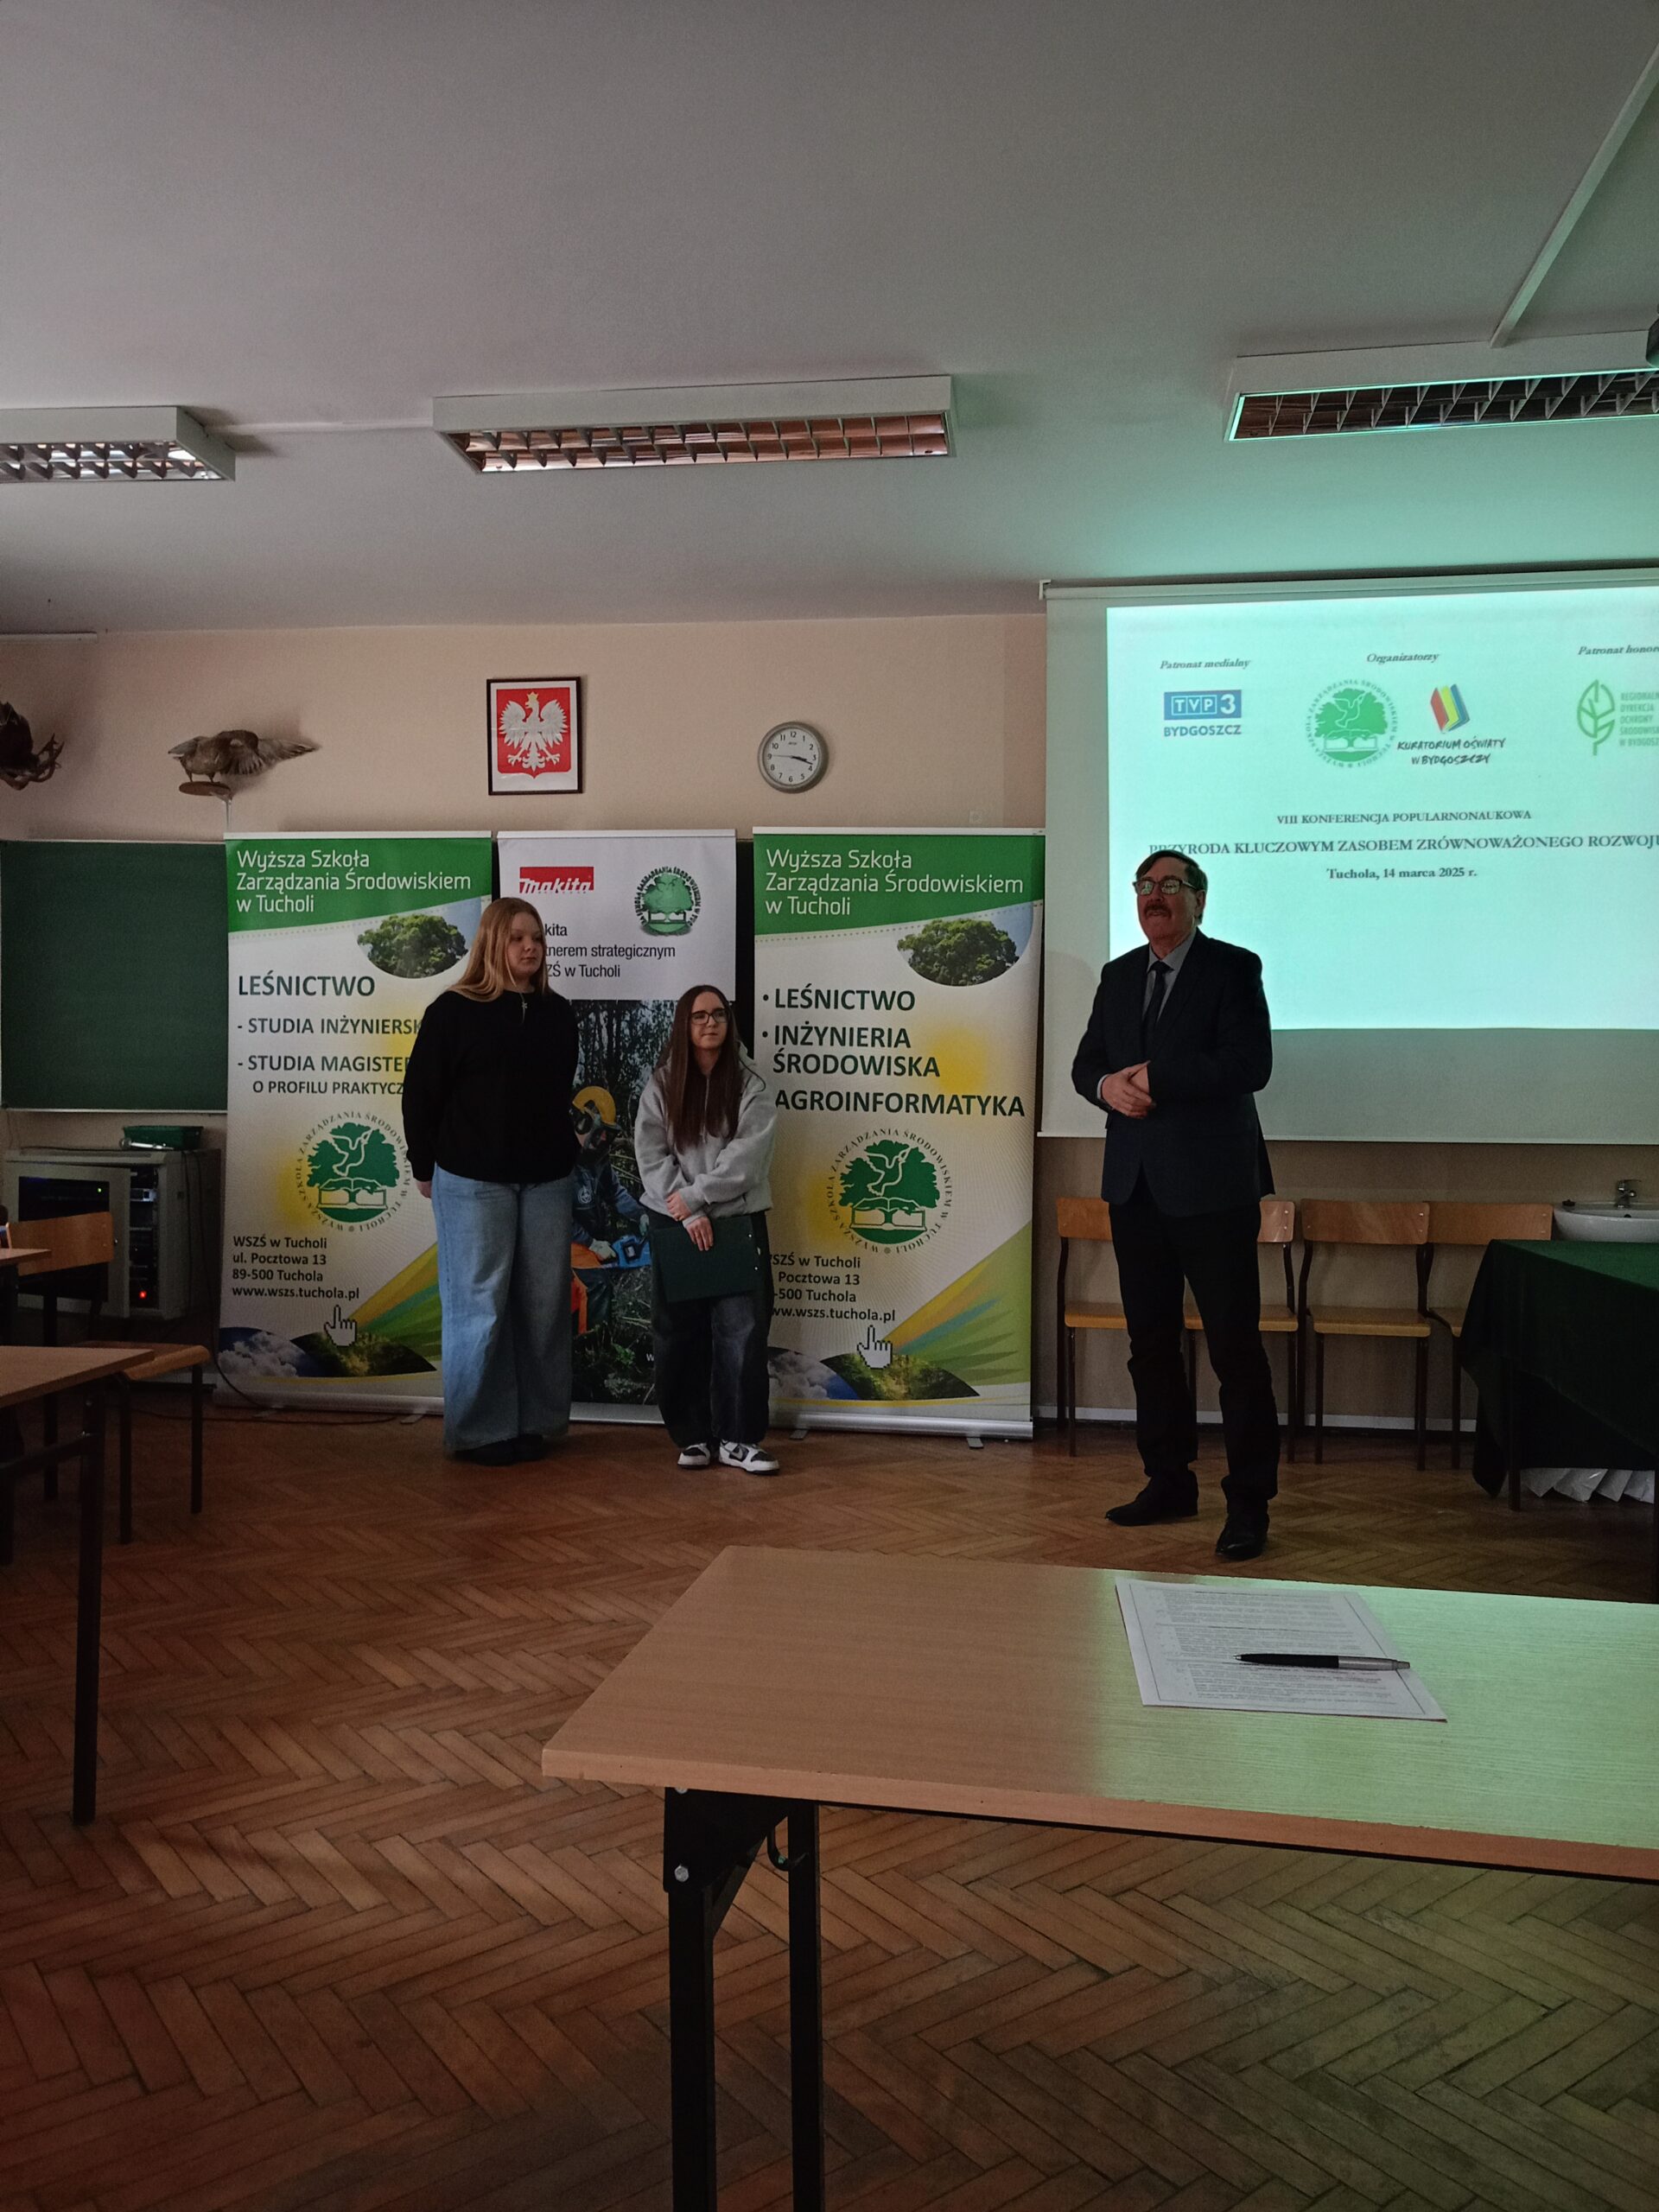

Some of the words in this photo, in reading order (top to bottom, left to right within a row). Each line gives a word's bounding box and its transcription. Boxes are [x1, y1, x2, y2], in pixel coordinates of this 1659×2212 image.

[1578, 645, 1624, 655] Patronat
[1160, 660, 1202, 670] Patronat
[1204, 658, 1251, 670] medialny
[1367, 652, 1440, 664] Organizatorzy
[1163, 724, 1242, 737] BYDGOSZCZ
[1397, 739, 1461, 751] KURATORIUM
[1463, 735, 1506, 749] OŚWIATY
[1421, 753, 1491, 766] BYDGOSZCZY
[1276, 815, 1298, 824] VIII
[1301, 813, 1389, 825] KONFERENCJA
[1392, 810, 1531, 823] POPULARNONAUKOWA
[1235, 841, 1334, 855] KLUCZOWYM
[1338, 838, 1414, 852] ZASOBEM
[1416, 835, 1583, 851] ZRÓWNOWAŻONEGO
[237, 850, 305, 872] Wyższa
[311, 850, 370, 868] Szkoła
[766, 849, 842, 873] Wyższa
[848, 849, 912, 868] Szkoła
[237, 873, 340, 894] Zarządzania
[346, 868, 471, 890] Środowiskiem
[1327, 868, 1380, 880] Tuchola,
[1383, 868, 1395, 879] 14
[1399, 869, 1435, 878] marca
[1439, 868, 1465, 878] 2025
[1468, 869, 1478, 878] r.
[766, 873, 879, 895] Zarządzania
[885, 870, 1023, 893] Środowiskiem
[237, 899, 251, 912] w
[258, 894, 315, 912] Tucholi
[766, 901, 782, 914] w
[787, 896, 850, 915] Tucholi
[591, 944, 676, 960] strategicznym
[565, 967, 576, 977] w
[579, 964, 620, 978] Tucholi
[238, 970, 375, 996] LEŚNICTWO
[775, 983, 915, 1011] LEŚNICTWO
[248, 1018, 314, 1033] STUDIA
[774, 1020, 911, 1048] INŻYNIERIA
[248, 1055, 315, 1071] STUDIA
[772, 1047, 940, 1077] ŚRODOWISKA
[252, 1080, 264, 1094] O
[268, 1081, 327, 1094] PROFILU
[775, 1090, 1025, 1116] AGROINFORMATYKA
[233, 1234, 267, 1247] WSZŚ
[270, 1239, 281, 1248] w
[284, 1237, 327, 1249] Tucholi
[232, 1253, 247, 1263] ul.
[251, 1253, 308, 1265] Pocztowa
[313, 1255, 327, 1265] 13
[798, 1257, 810, 1267] w
[814, 1255, 861, 1268] Tucholi
[232, 1268, 274, 1281] 89-500
[276, 1269, 323, 1281] Tuchola
[779, 1272, 841, 1285] Pocztowa
[845, 1274, 860, 1286] 13
[232, 1287, 359, 1301] www.wszs.tuchola.pl
[806, 1289, 856, 1302] Tuchola
